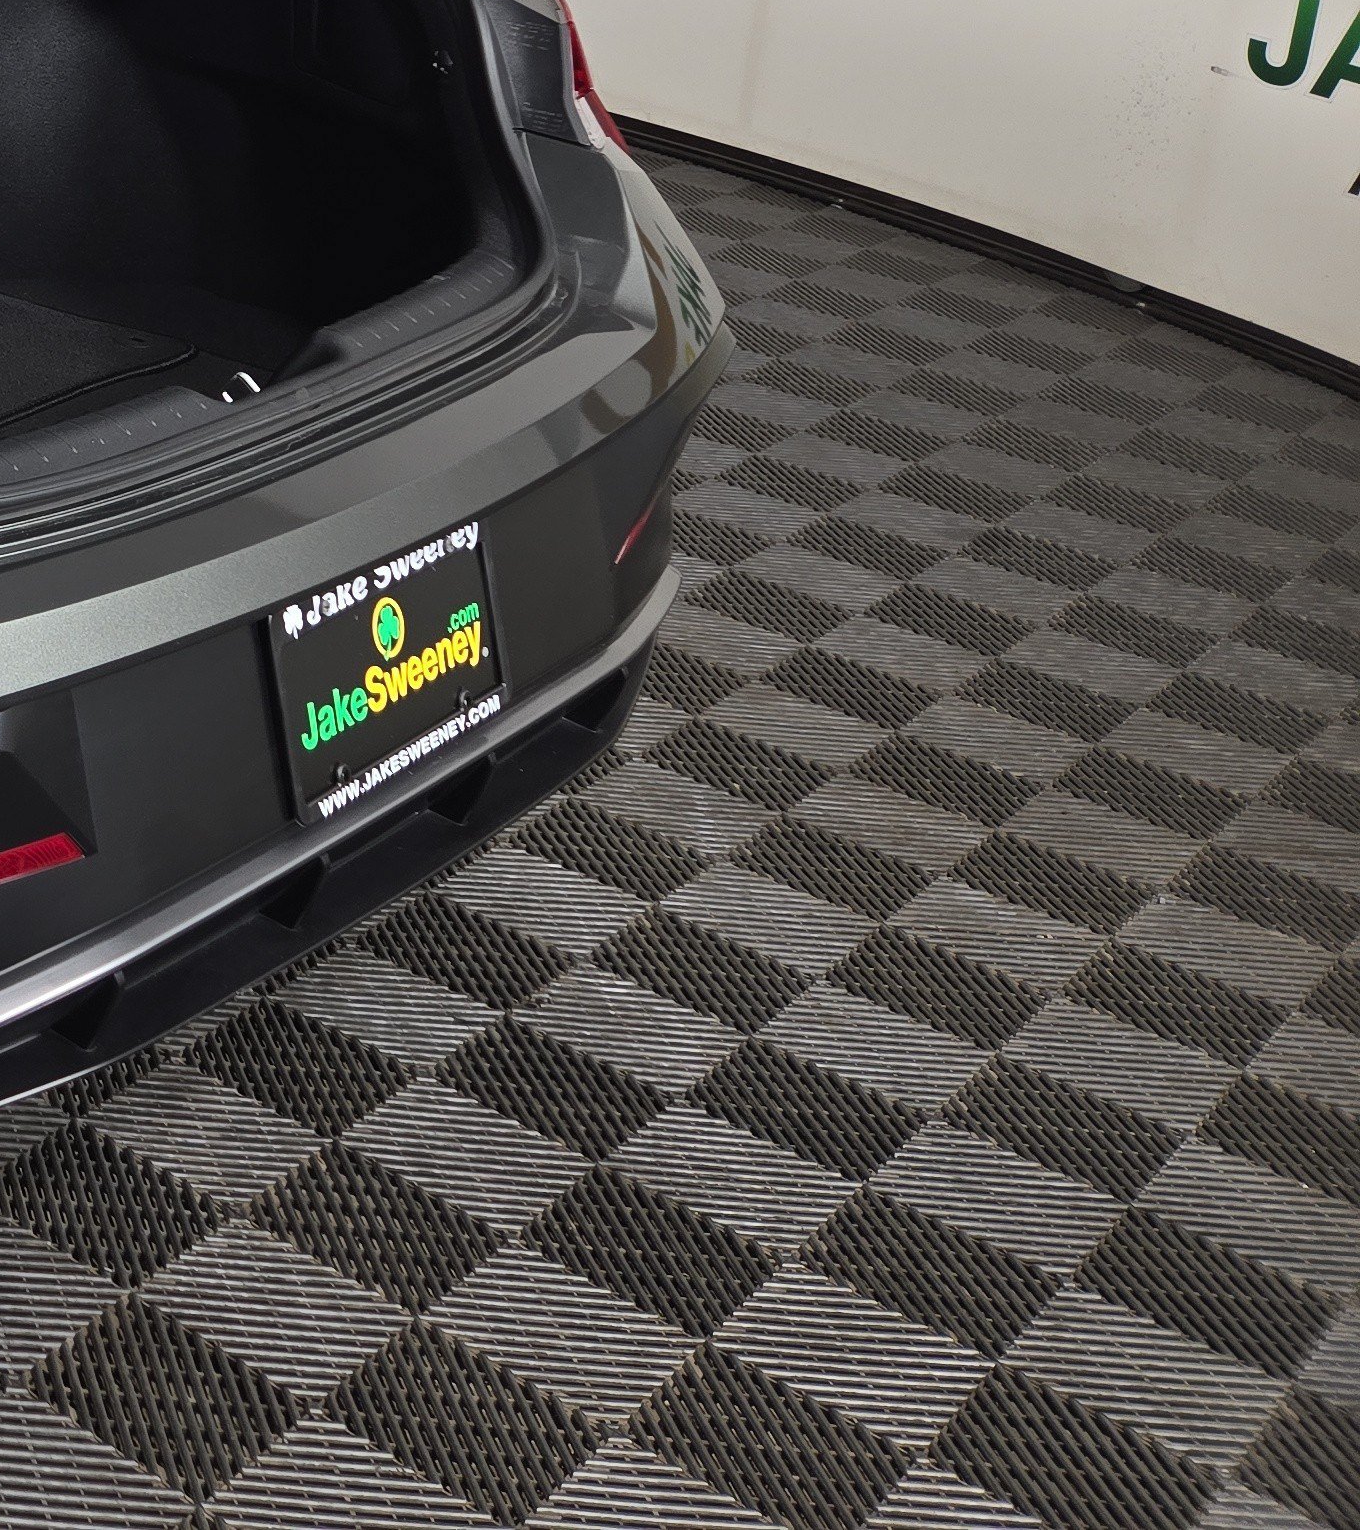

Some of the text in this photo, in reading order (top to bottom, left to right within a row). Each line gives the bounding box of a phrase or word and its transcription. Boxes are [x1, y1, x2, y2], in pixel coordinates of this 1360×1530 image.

[306, 575, 369, 626] Jake
[446, 602, 480, 634] .com
[317, 694, 501, 818] WWW.JAKESWEENEY.COM
